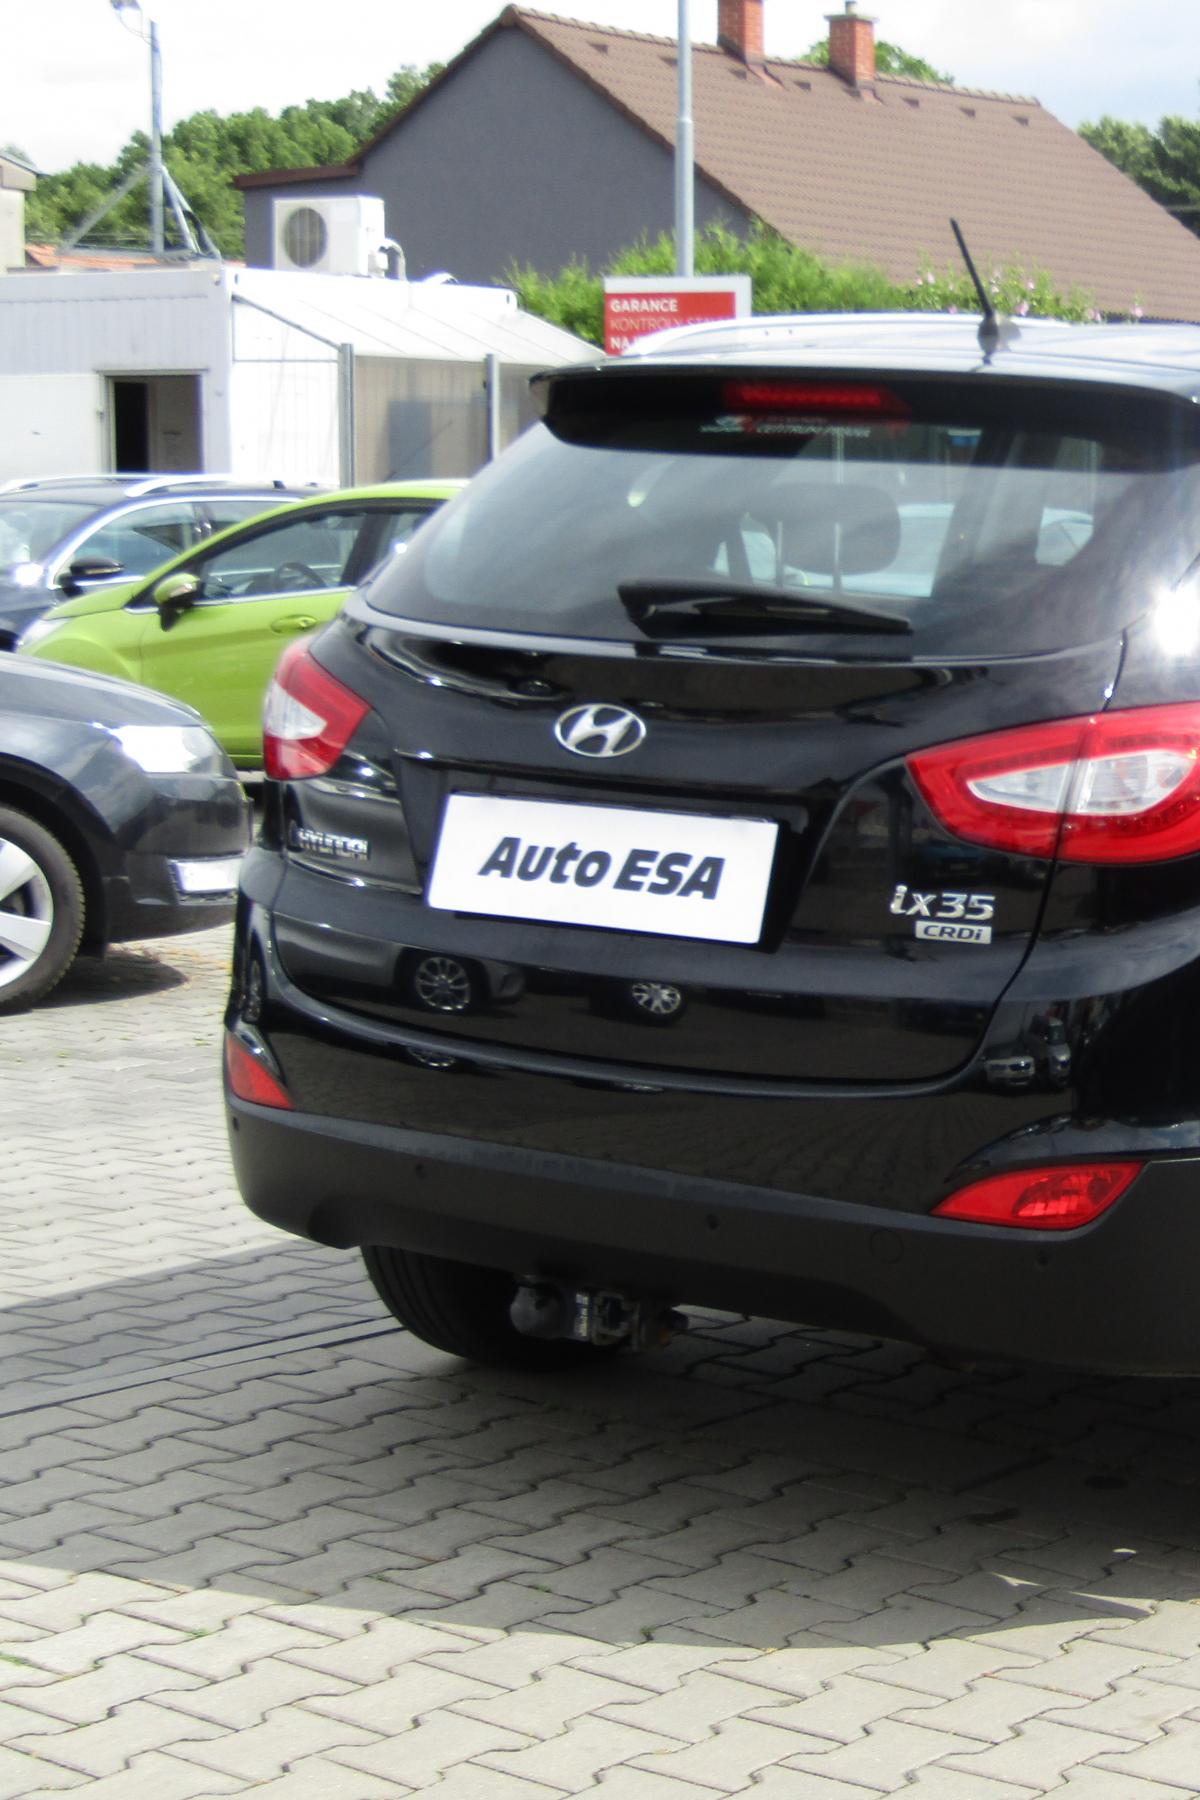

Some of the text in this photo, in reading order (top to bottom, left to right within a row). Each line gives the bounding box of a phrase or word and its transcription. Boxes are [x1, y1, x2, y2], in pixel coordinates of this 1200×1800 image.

[611, 299, 678, 313] GARANCE
[478, 837, 725, 899] Auto ESA
[890, 885, 995, 920] ix35
[923, 925, 983, 940] CRDi
